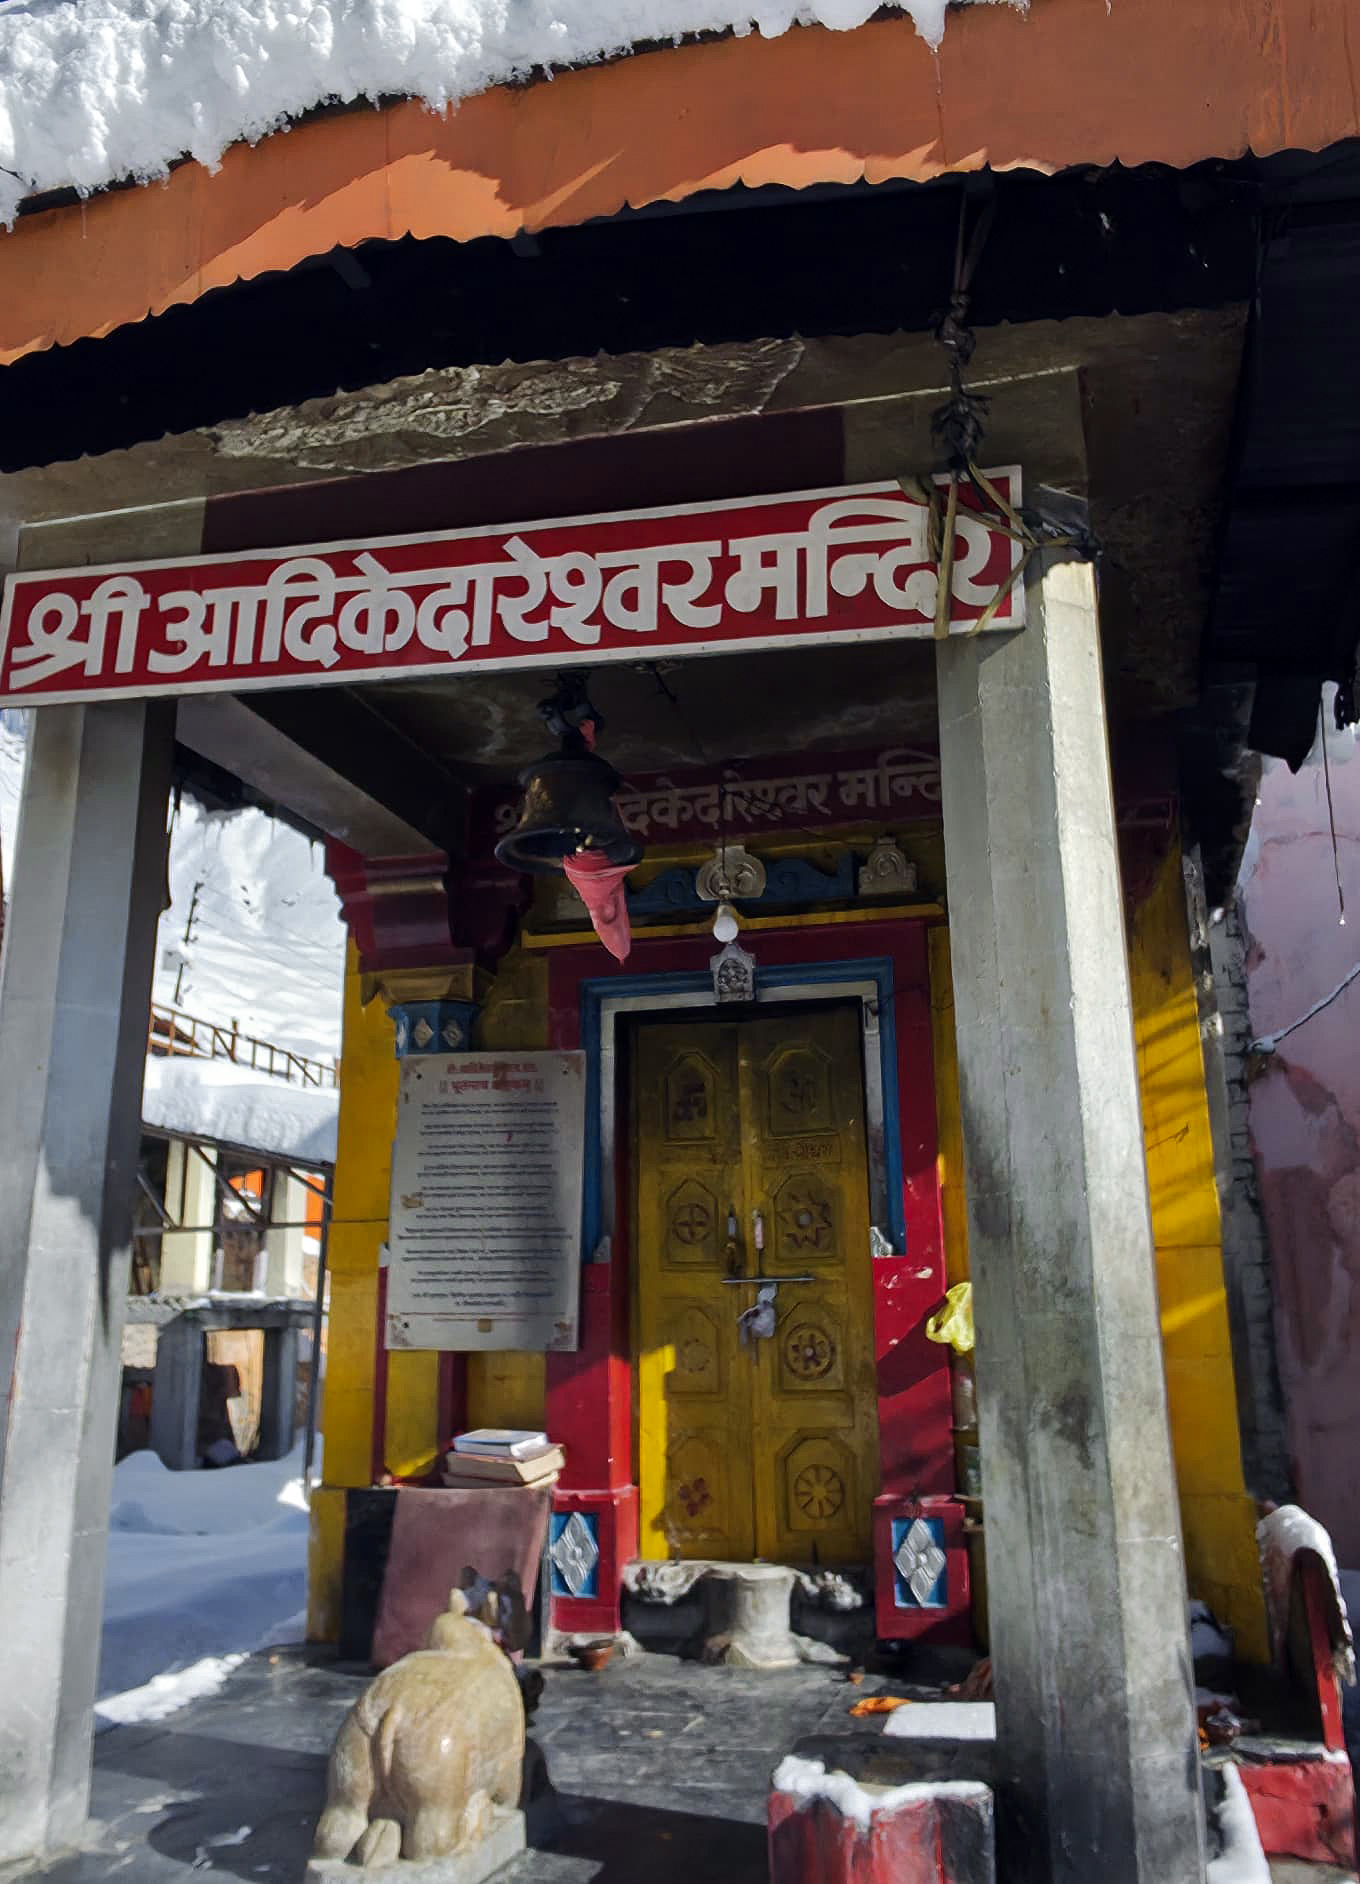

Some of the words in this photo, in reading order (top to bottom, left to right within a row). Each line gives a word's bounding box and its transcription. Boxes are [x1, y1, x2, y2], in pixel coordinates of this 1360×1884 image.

[9, 575, 150, 691] श्री
[147, 535, 723, 675] आदिकेदारेश्वर
[724, 498, 1001, 621] मन्दिर
[836, 748, 941, 809] मन्दि
